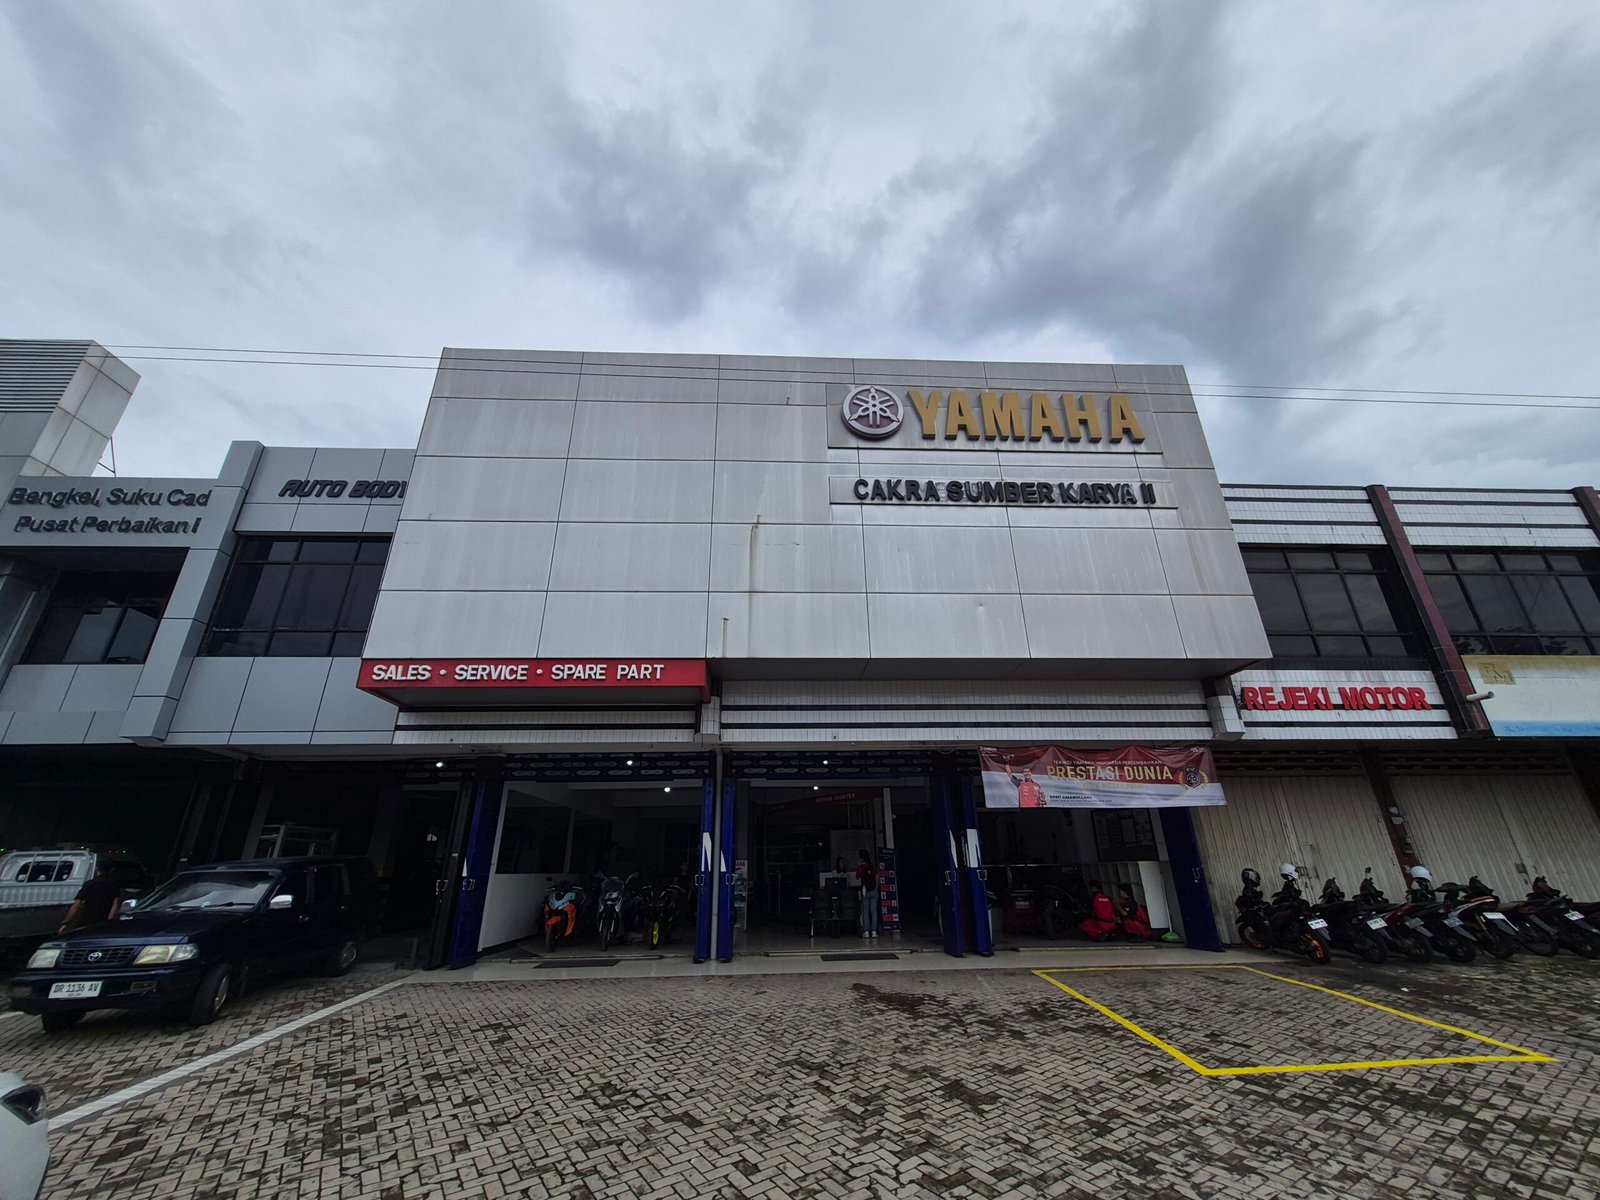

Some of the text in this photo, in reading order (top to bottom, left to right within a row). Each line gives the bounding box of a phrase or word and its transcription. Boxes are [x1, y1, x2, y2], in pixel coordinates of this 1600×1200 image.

[907, 388, 1146, 444] YAMAHA
[7, 487, 213, 509] Bengkel, Suku Cad
[278, 479, 349, 498] AUTO
[853, 478, 1157, 505] CAKRA SUMBER KARYA II
[13, 515, 81, 533] Pusat
[80, 516, 193, 534] Perbaikan
[371, 664, 665, 681] SALES SERVICE SPARE PART
[1241, 686, 1433, 711] REJEKI MOTOR
[1047, 765, 1119, 780] PRESTASI
[1124, 765, 1174, 780] DUNIA
